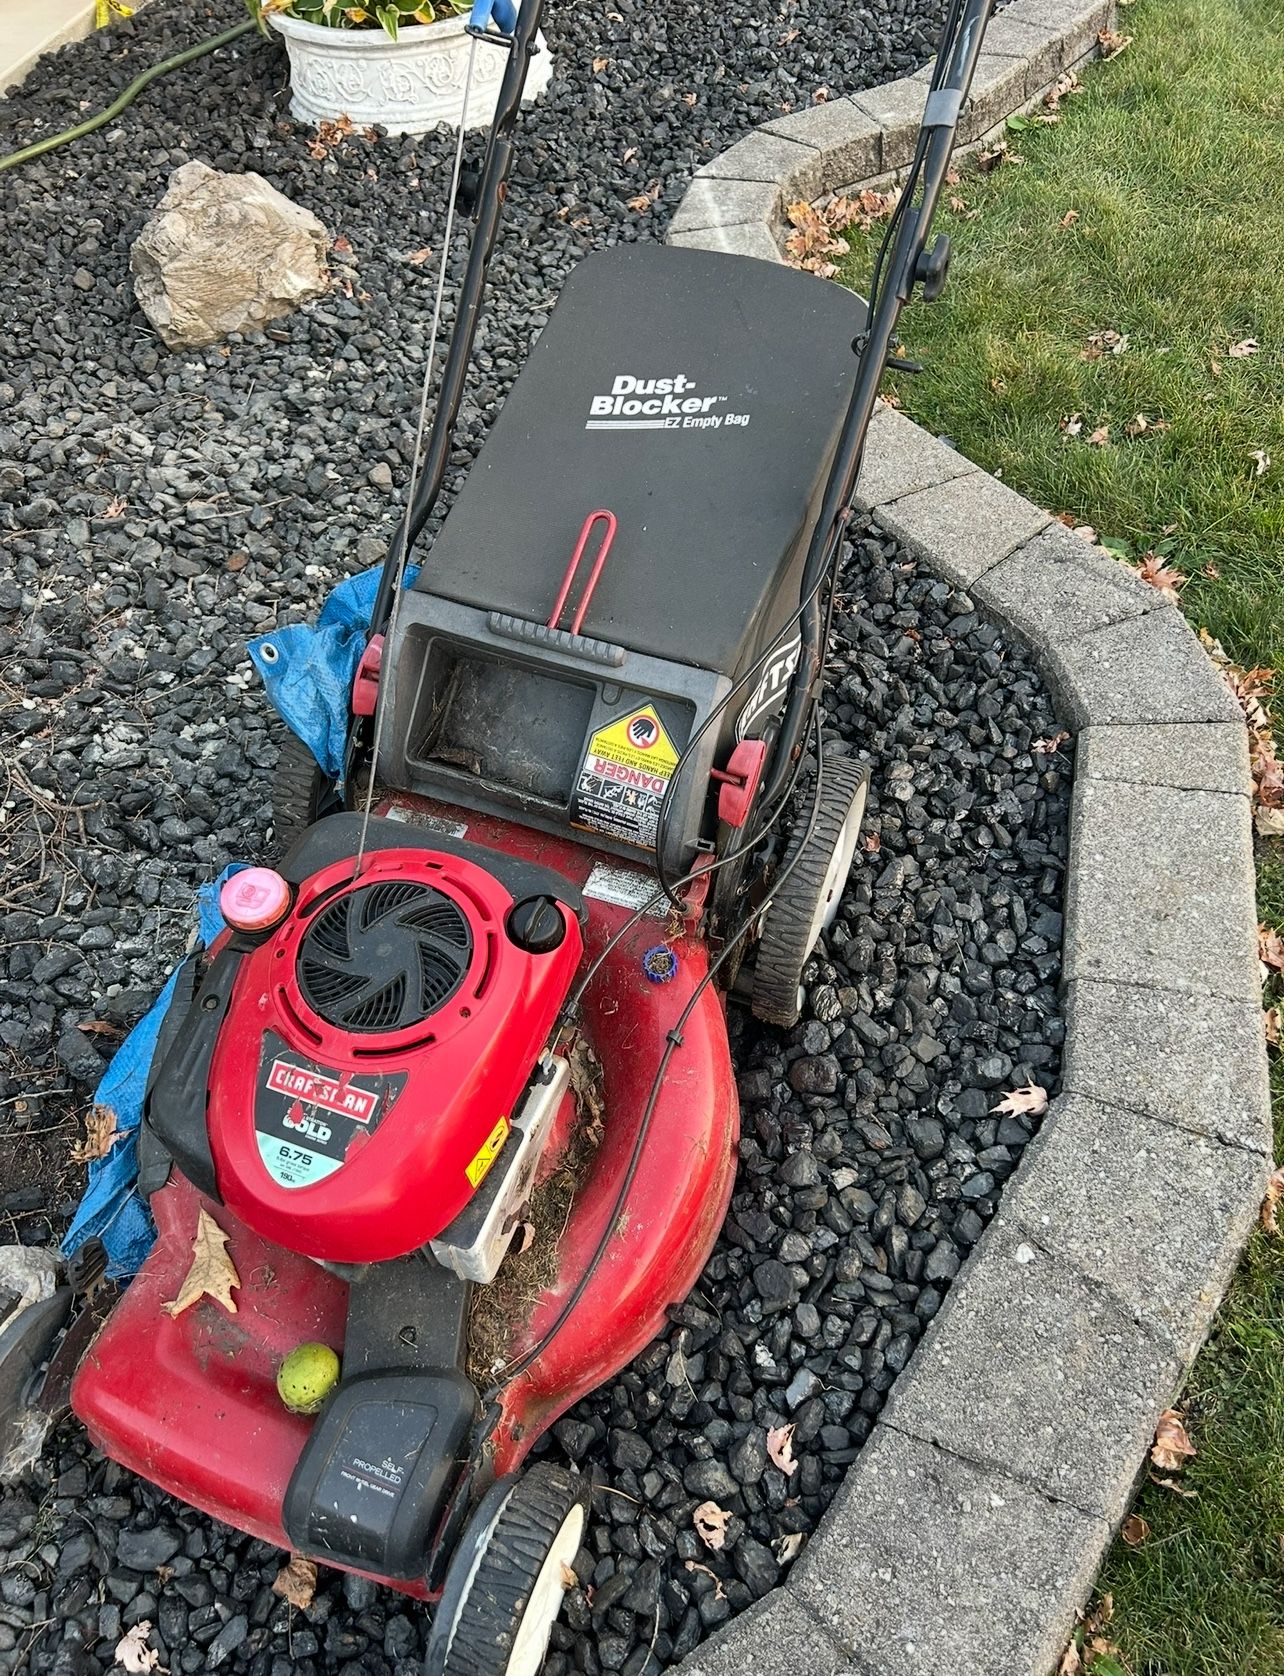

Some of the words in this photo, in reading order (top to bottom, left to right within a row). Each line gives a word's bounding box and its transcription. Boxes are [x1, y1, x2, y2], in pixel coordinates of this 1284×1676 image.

[611, 374, 696, 395] Dust-
[664, 417, 680, 428] EZ
[682, 416, 723, 429] Empty
[724, 414, 750, 426] Bag
[593, 747, 610, 757] AWAY
[610, 753, 624, 762] FEET
[625, 758, 637, 766] AND
[638, 762, 658, 773] HANDS
[594, 758, 665, 793] DANGER
[274, 1069, 368, 1113] CRAFSAN
[282, 1114, 332, 1141] GOLD
[279, 1146, 313, 1165] 6.75
[353, 1458, 401, 1484] PROPELLED
